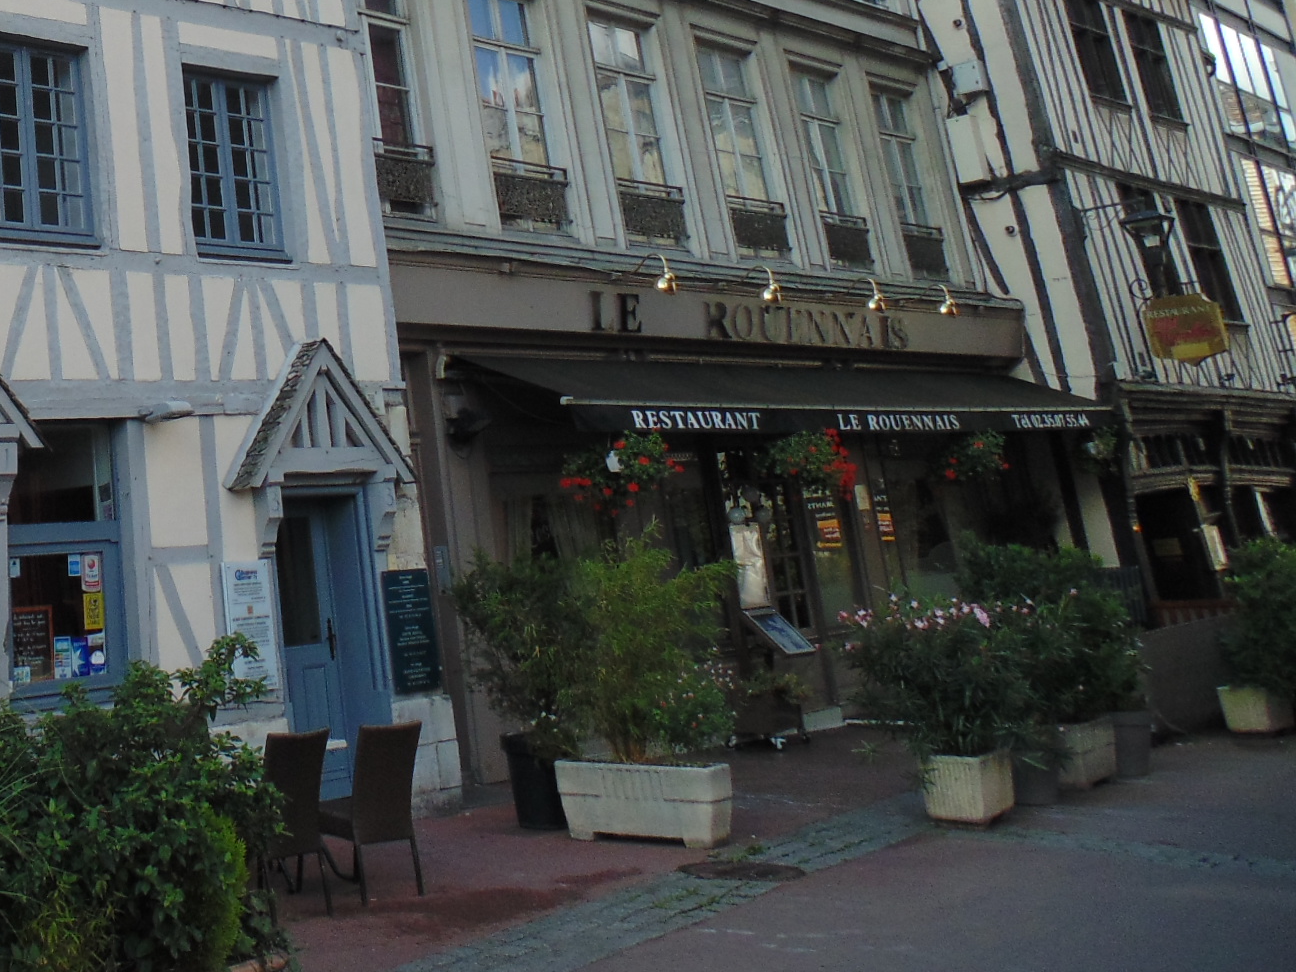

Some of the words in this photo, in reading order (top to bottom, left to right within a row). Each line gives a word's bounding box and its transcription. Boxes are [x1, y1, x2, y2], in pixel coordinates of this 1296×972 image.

[588, 290, 642, 334] LE
[703, 301, 910, 350] ROUENNAIS
[631, 410, 761, 430] RESTAURANT
[837, 414, 861, 431] LE
[868, 414, 960, 430] ROUENNAIS
